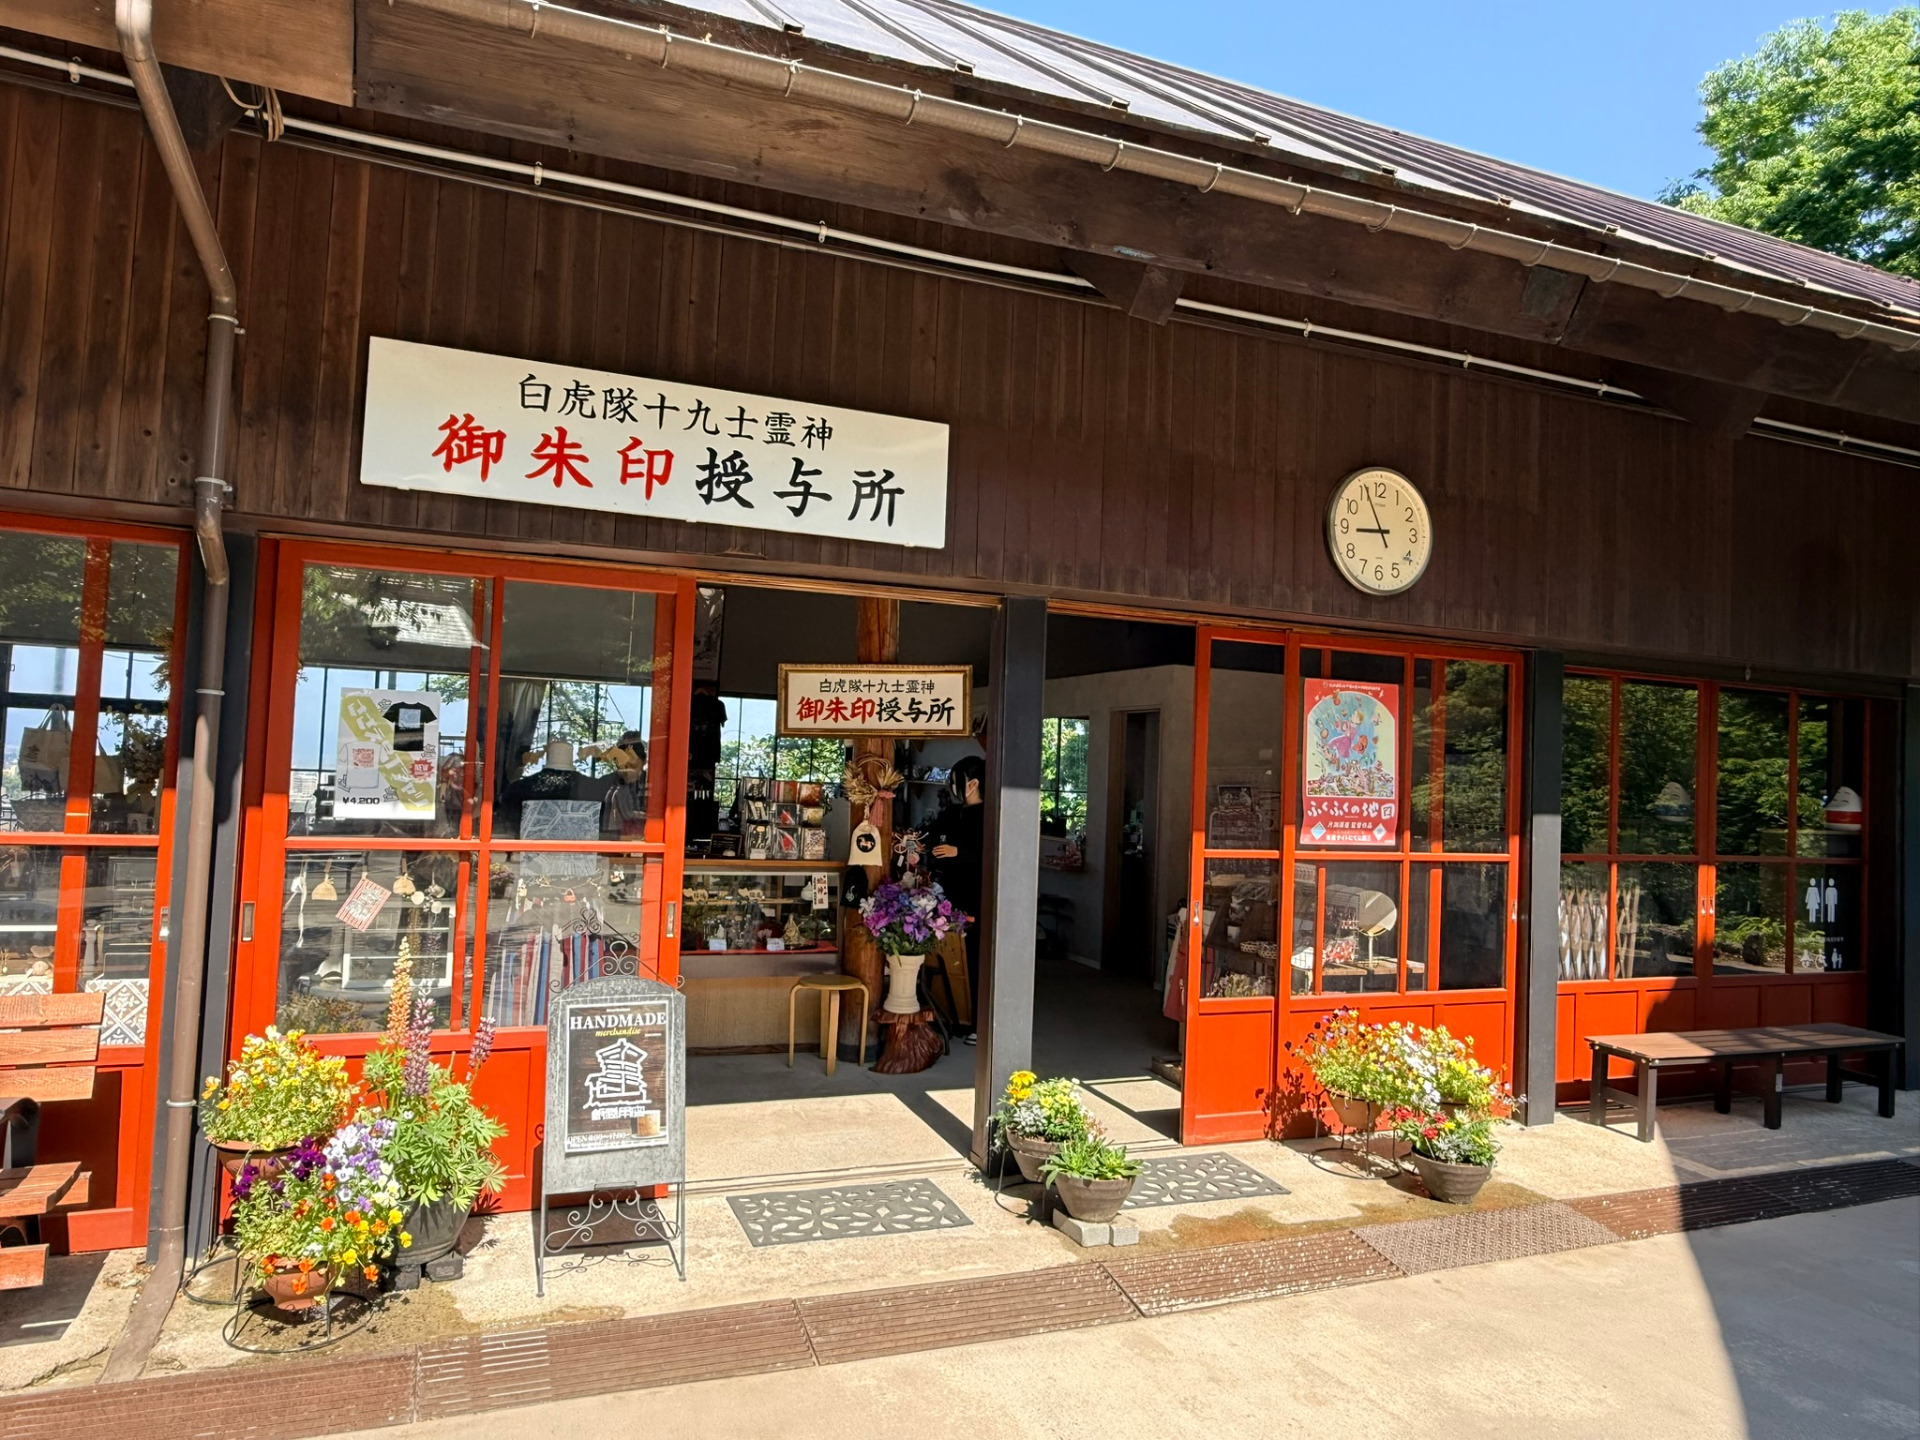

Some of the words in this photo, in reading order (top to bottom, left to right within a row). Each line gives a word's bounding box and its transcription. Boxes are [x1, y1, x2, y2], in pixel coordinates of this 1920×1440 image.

[518, 373, 833, 451] 白虎隊十九士霊神
[431, 413, 905, 526] 御朱印授与所
[1374, 482, 1387, 499] 12
[1346, 498, 1358, 515] 10
[1404, 507, 1414, 523] 2
[1340, 518, 1349, 534] 9
[1408, 528, 1418, 544] 3
[1346, 542, 1355, 559] 8
[1359, 558, 1368, 575] 7
[1374, 564, 1384, 581] 6
[1391, 562, 1400, 579] 5
[819, 678, 935, 694] 白虎隊十九士霊神
[796, 696, 955, 726] 御朱印授与所
[570, 1012, 666, 1030] HANDMADE
[595, 1027, 641, 1037] merchandise
